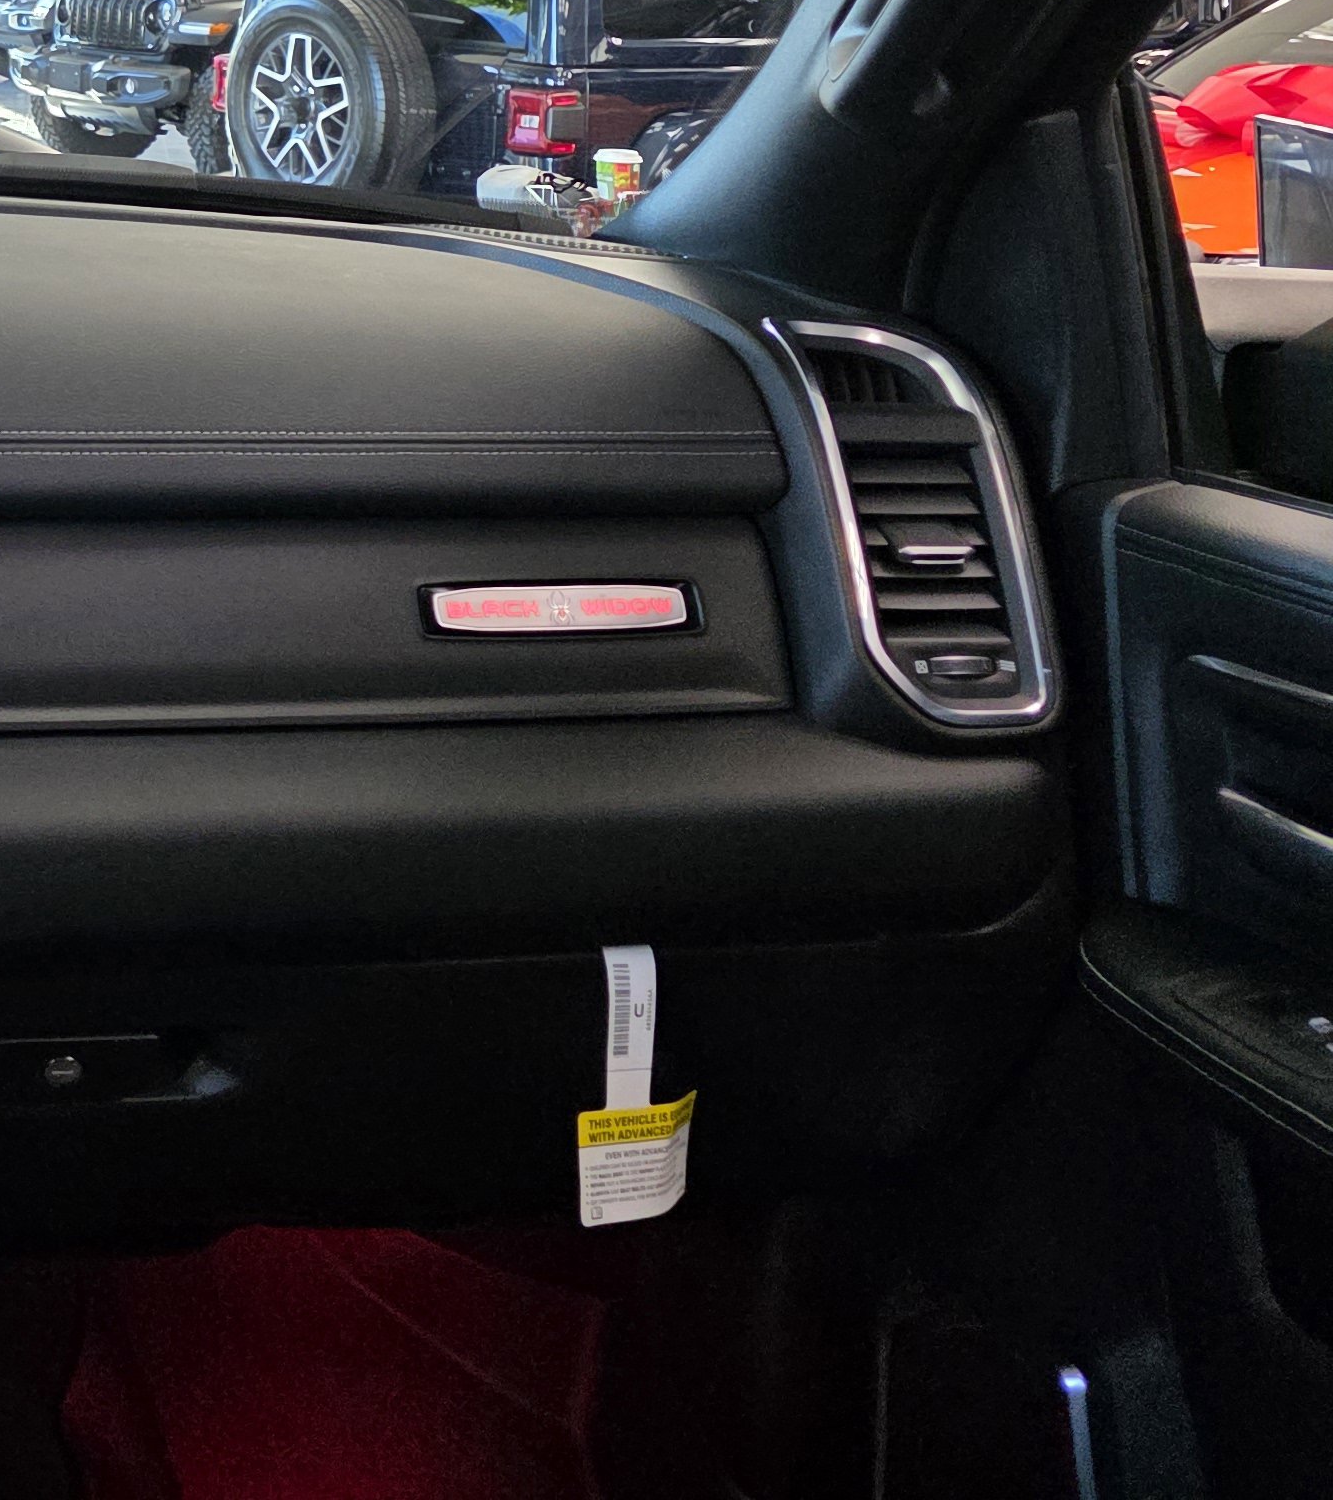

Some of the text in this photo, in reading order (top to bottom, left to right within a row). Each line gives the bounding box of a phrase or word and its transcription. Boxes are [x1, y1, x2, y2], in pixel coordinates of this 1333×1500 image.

[445, 597, 673, 619] BLACK WIDOW
[589, 1112, 667, 1130] THIS VEHICLE IS
[589, 1125, 671, 1142] WITH ADVANCED
[605, 1151, 621, 1160] EVEN
